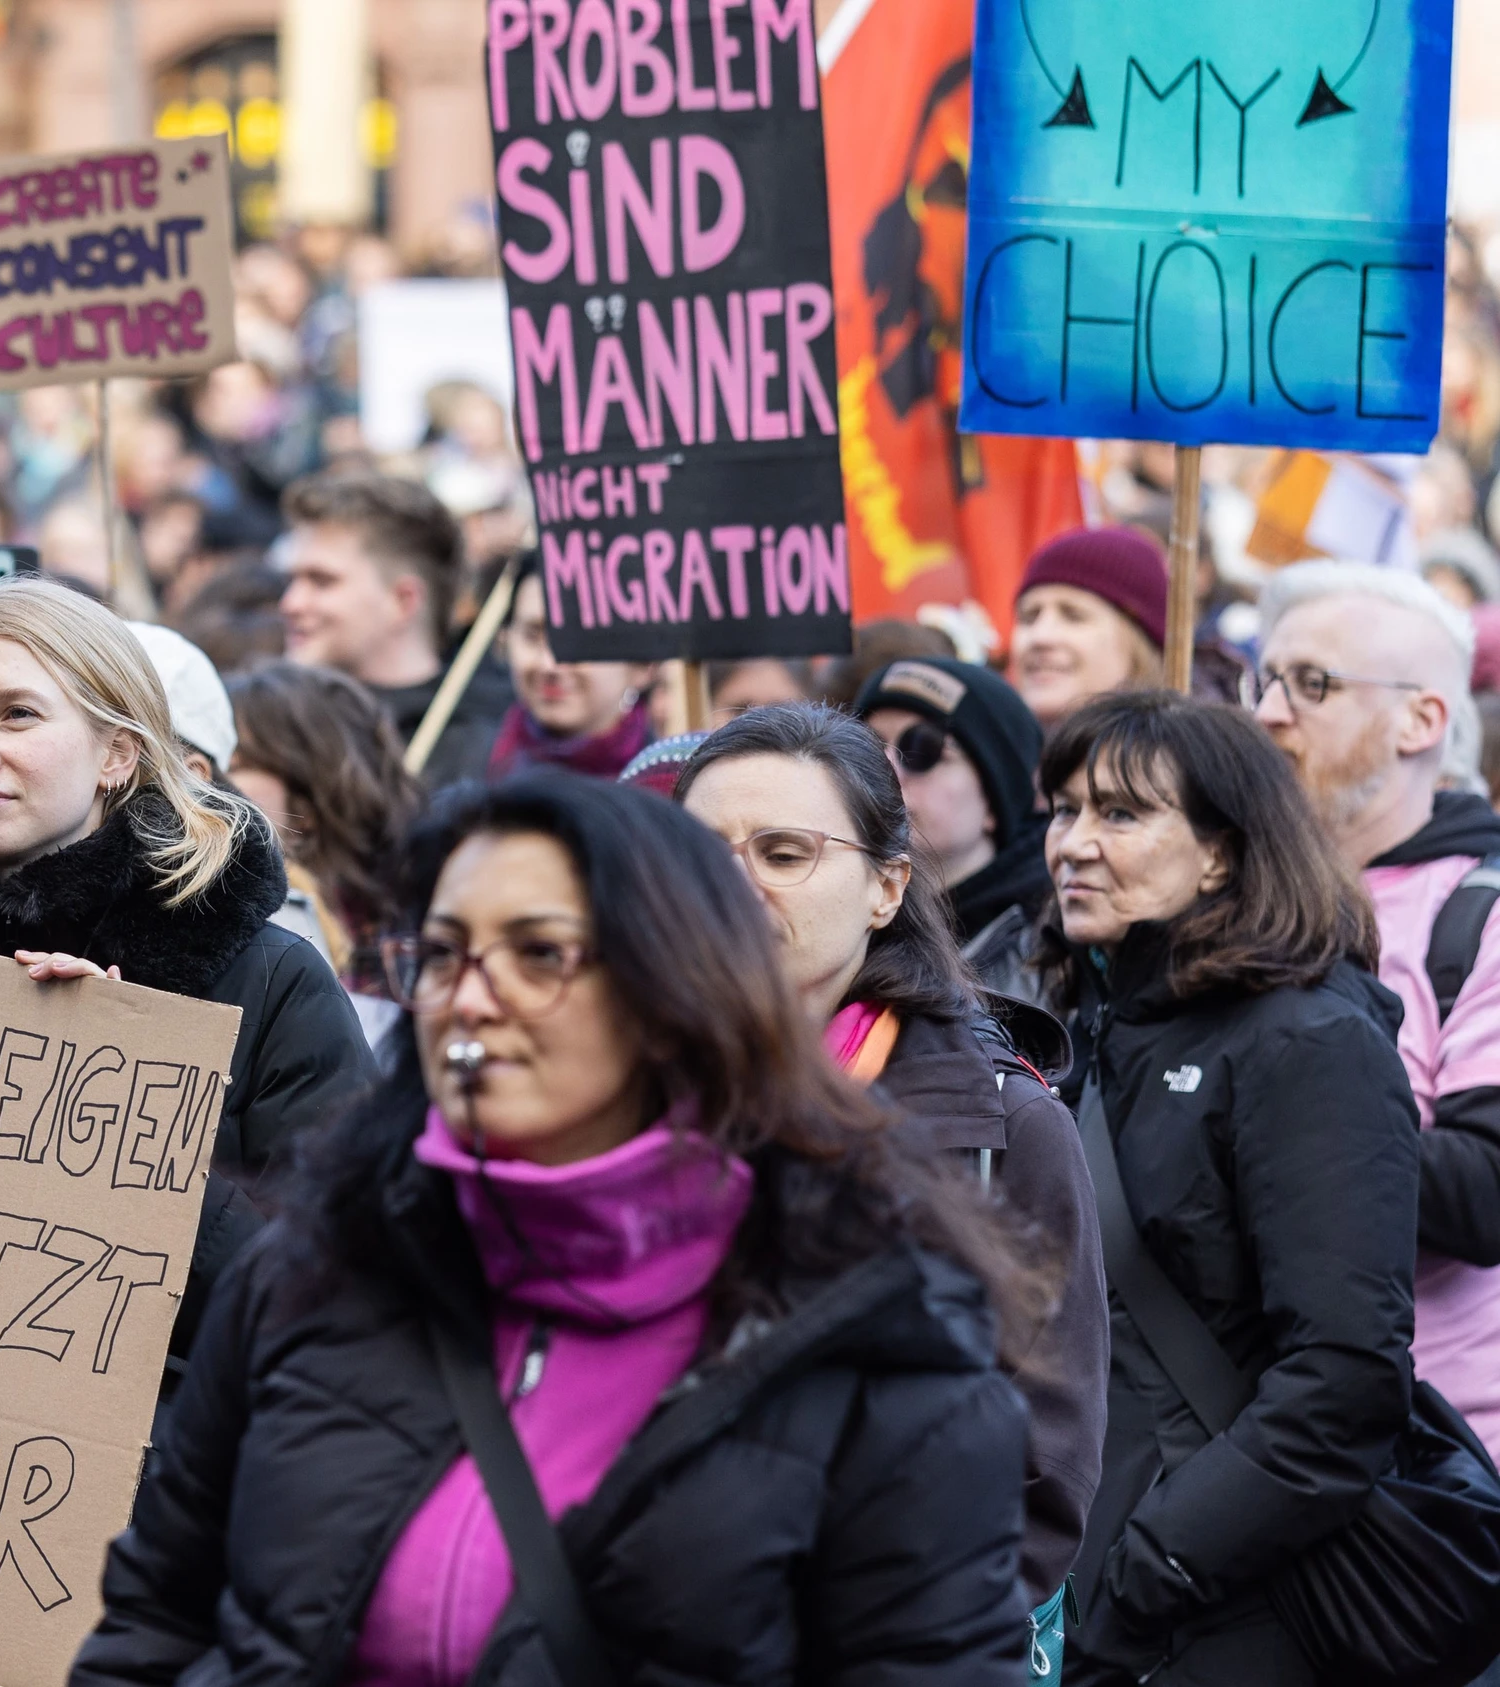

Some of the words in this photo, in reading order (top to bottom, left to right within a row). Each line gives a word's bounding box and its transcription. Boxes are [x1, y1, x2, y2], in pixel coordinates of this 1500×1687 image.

[487, 0, 818, 132] PROBLEM
[1115, 55, 1282, 198] MY
[511, 282, 837, 463] MÄNNER
[971, 233, 1435, 421] CHOICE
